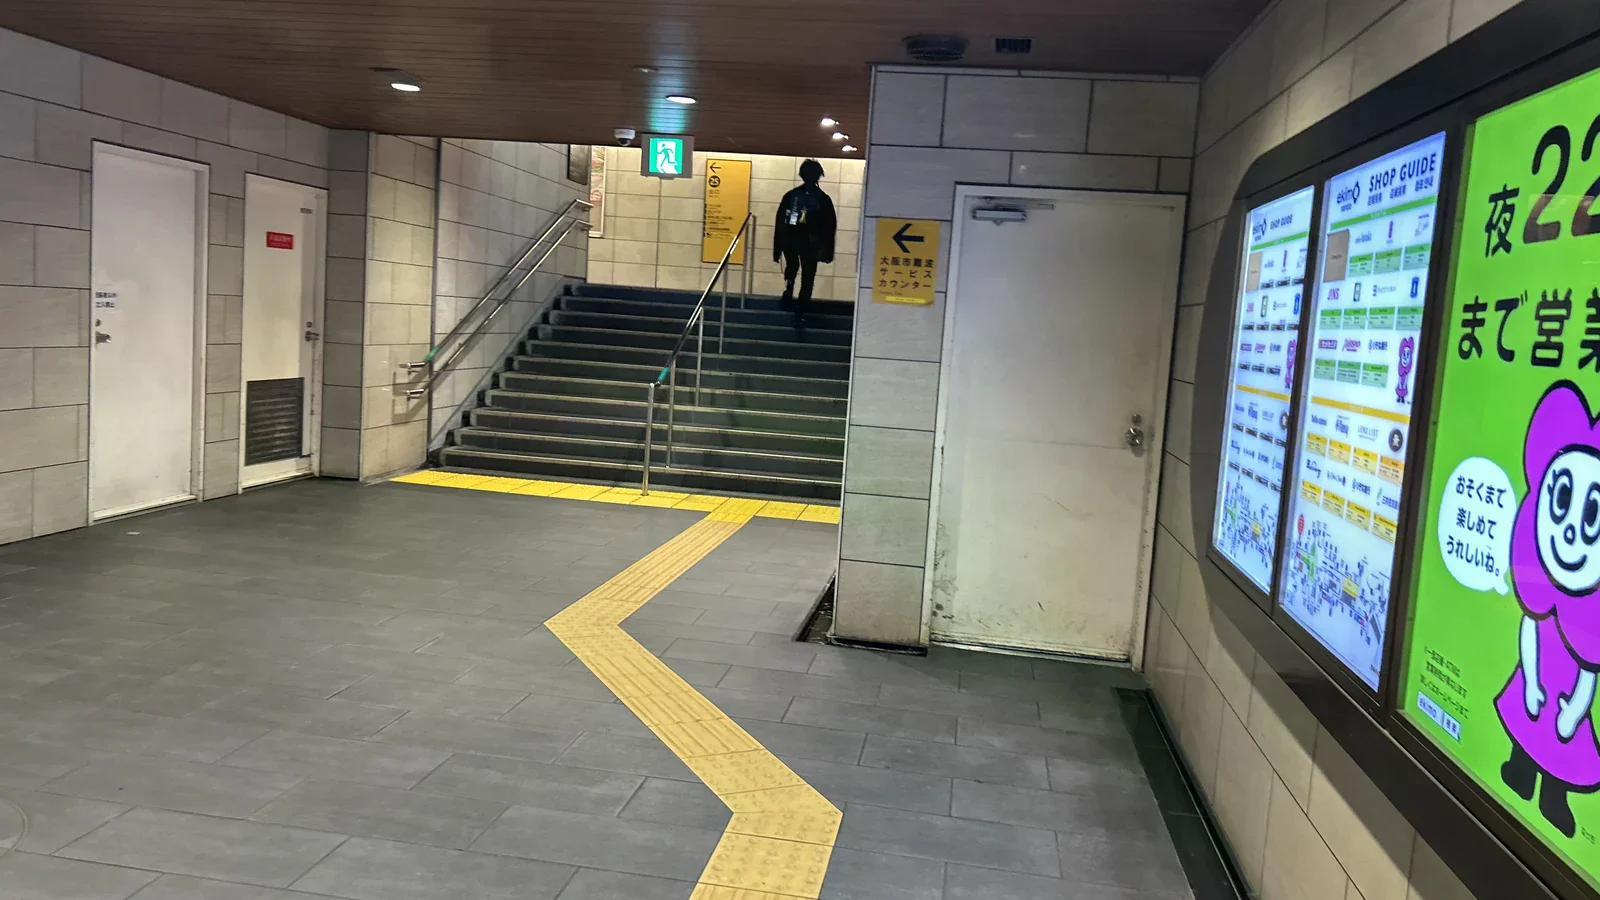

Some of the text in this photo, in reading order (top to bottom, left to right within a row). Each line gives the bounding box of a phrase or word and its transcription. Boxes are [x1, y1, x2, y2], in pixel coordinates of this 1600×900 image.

[1369, 168, 1396, 192] SHOP
[1399, 152, 1436, 181] GUIDE
[709, 176, 720, 187] 25
[880, 256, 934, 269] 大阪市難波
[879, 267, 932, 279] サービス
[878, 279, 931, 290] カウンター
[1455, 507, 1497, 540] 楽しめて
[1446, 535, 1500, 577] うれしいね。
